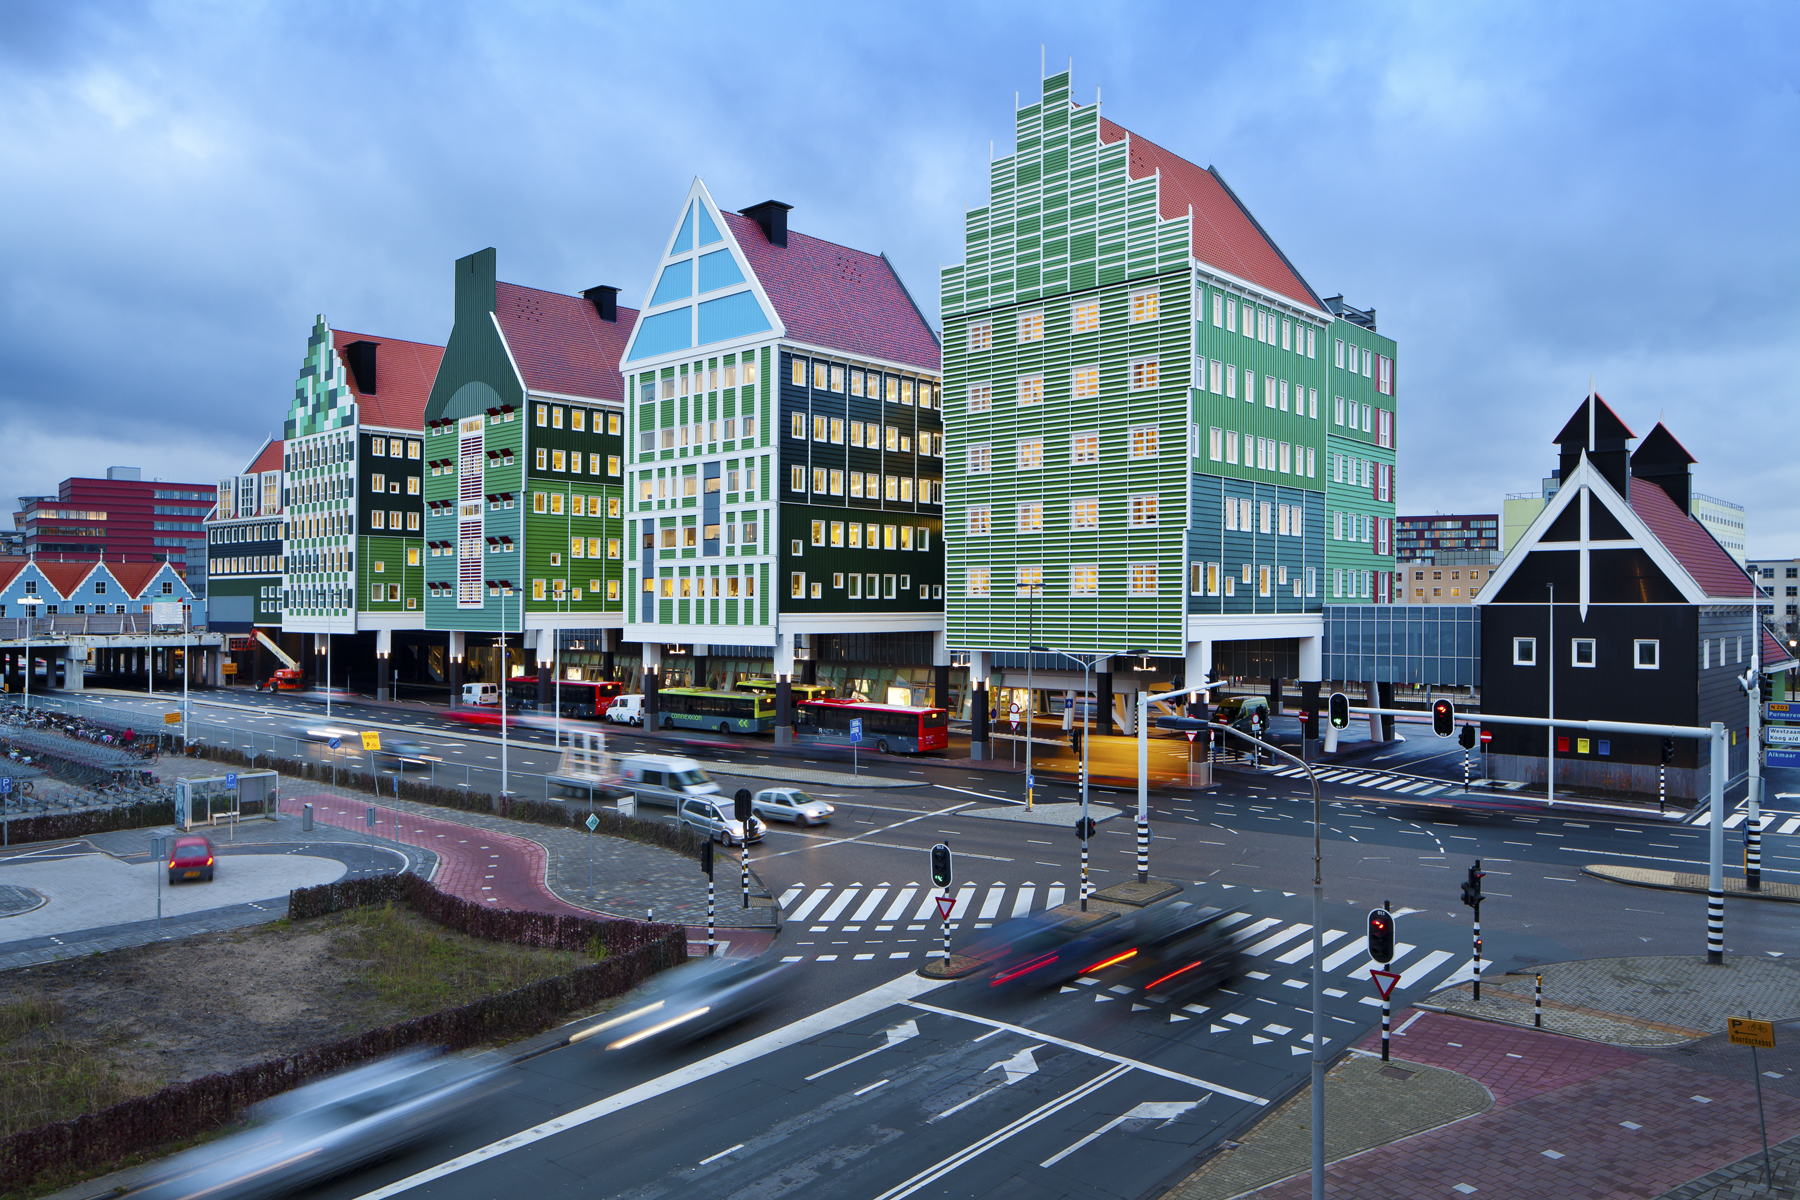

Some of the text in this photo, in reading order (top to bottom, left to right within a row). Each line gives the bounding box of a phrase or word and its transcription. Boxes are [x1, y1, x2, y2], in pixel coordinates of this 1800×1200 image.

[671, 712, 702, 722] connexxion
[2, 778, 10, 786] P
[228, 774, 234, 782] P
[1732, 1020, 1742, 1028] P
[1731, 1034, 1772, 1048] Noordschebos
